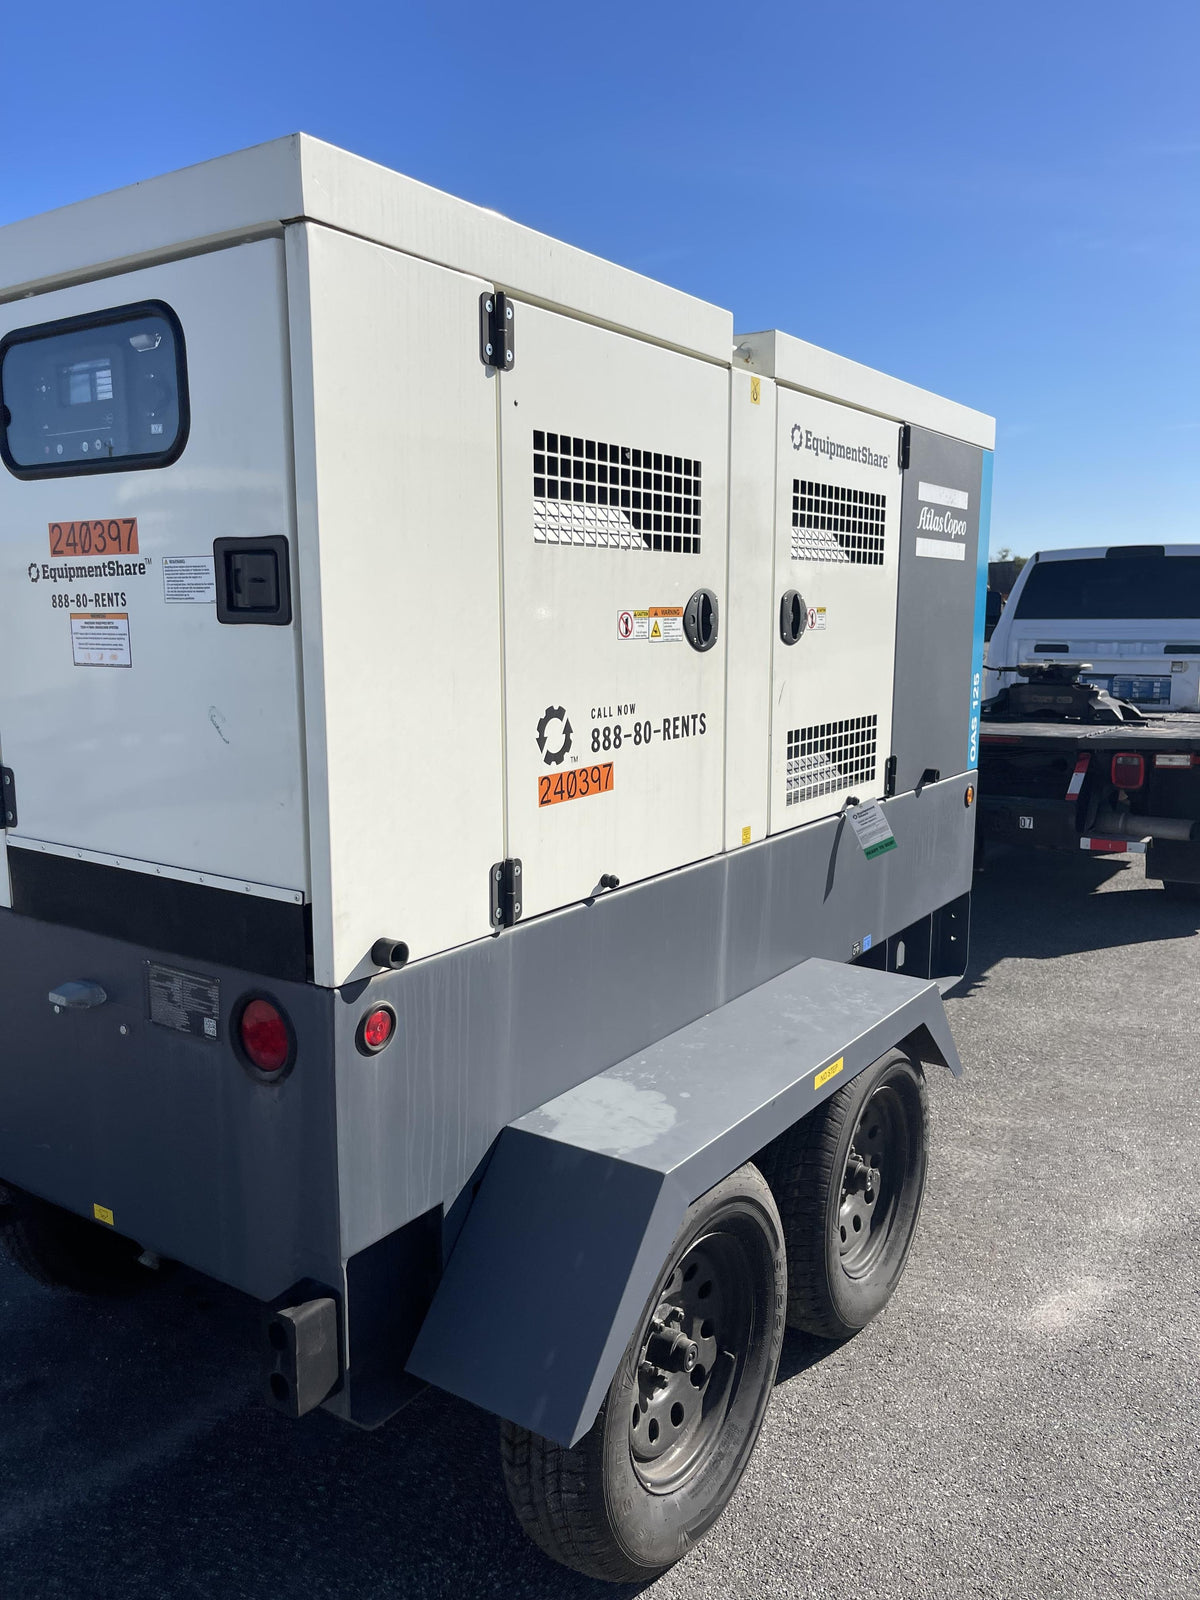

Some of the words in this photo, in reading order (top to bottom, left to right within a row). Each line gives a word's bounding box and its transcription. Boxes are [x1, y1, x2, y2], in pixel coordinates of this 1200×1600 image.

[804, 429, 889, 470] EquipmentShare
[51, 519, 136, 555] 240397
[916, 506, 943, 532] Atlas
[943, 511, 968, 539] Copco
[41, 560, 146, 582] EquipmentShare
[51, 592, 127, 608] 888-80-RENTS
[972, 672, 980, 709] 125
[591, 706, 613, 720] CALL
[617, 703, 636, 716] NOW
[591, 712, 707, 753] 888-80-RENTS
[539, 763, 613, 805] 240397
[1020, 817, 1032, 828] 07
